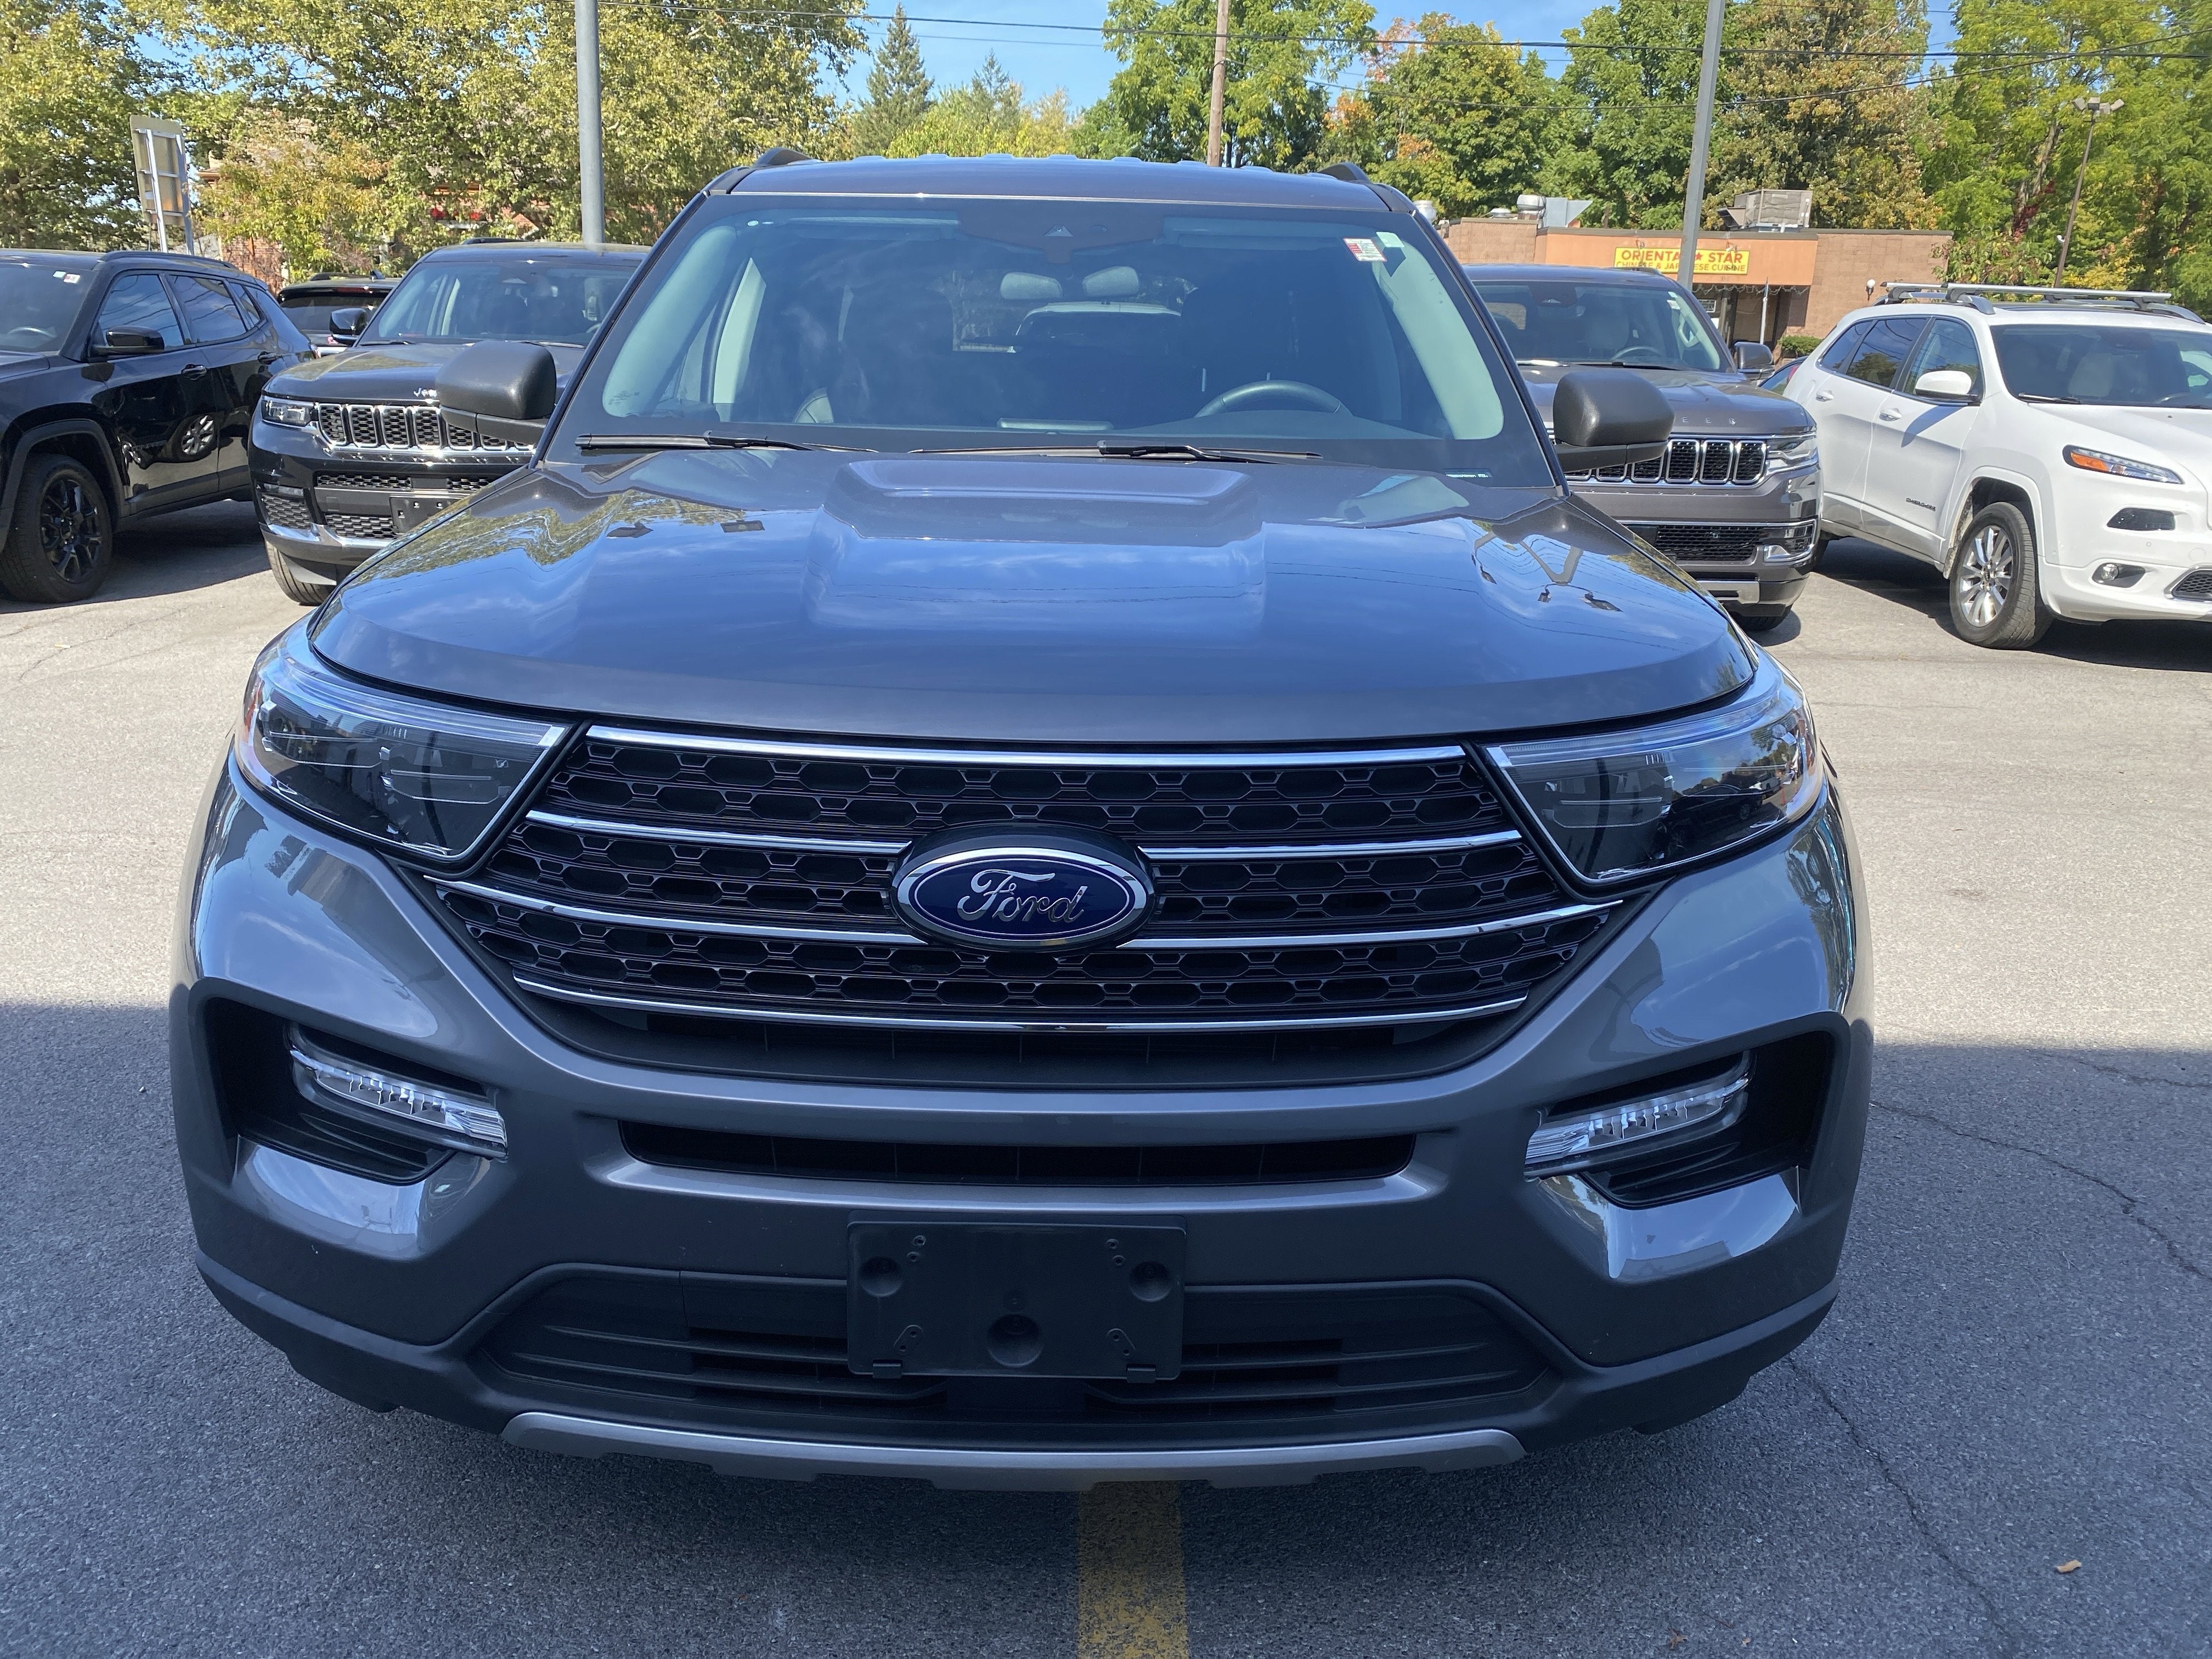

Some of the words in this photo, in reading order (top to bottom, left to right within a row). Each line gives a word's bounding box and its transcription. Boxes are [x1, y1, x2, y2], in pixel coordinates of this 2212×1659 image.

[1622, 250, 1680, 261] ORIENTA
[1708, 252, 1743, 263] STAR
[957, 869, 1088, 923] Ford
